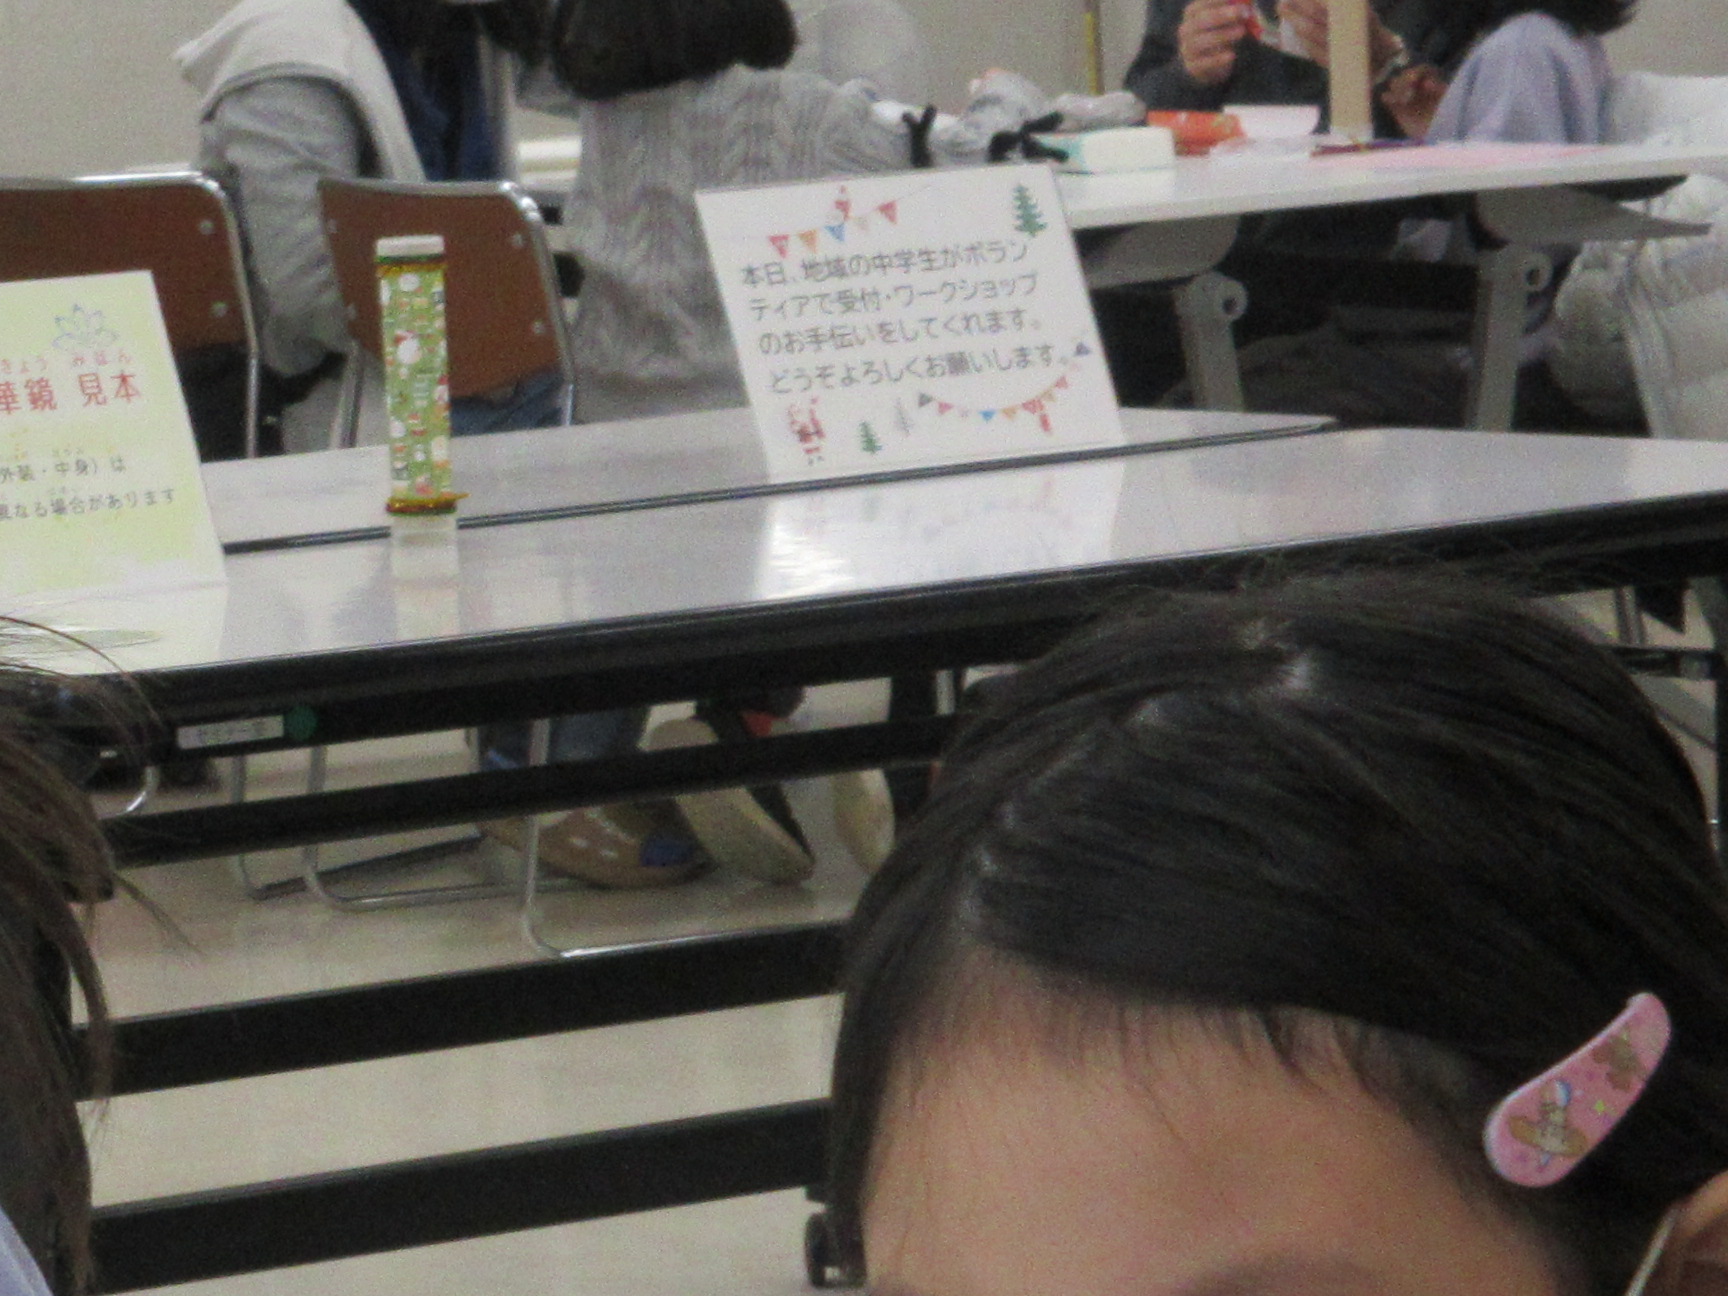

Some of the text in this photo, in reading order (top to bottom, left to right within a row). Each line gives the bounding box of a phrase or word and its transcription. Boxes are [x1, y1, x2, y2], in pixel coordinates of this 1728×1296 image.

[759, 308, 1042, 356] のお手伝いをしてくれます。
[79, 370, 143, 407] 見本
[769, 343, 1070, 394] どうぞよろしくお願いします。
